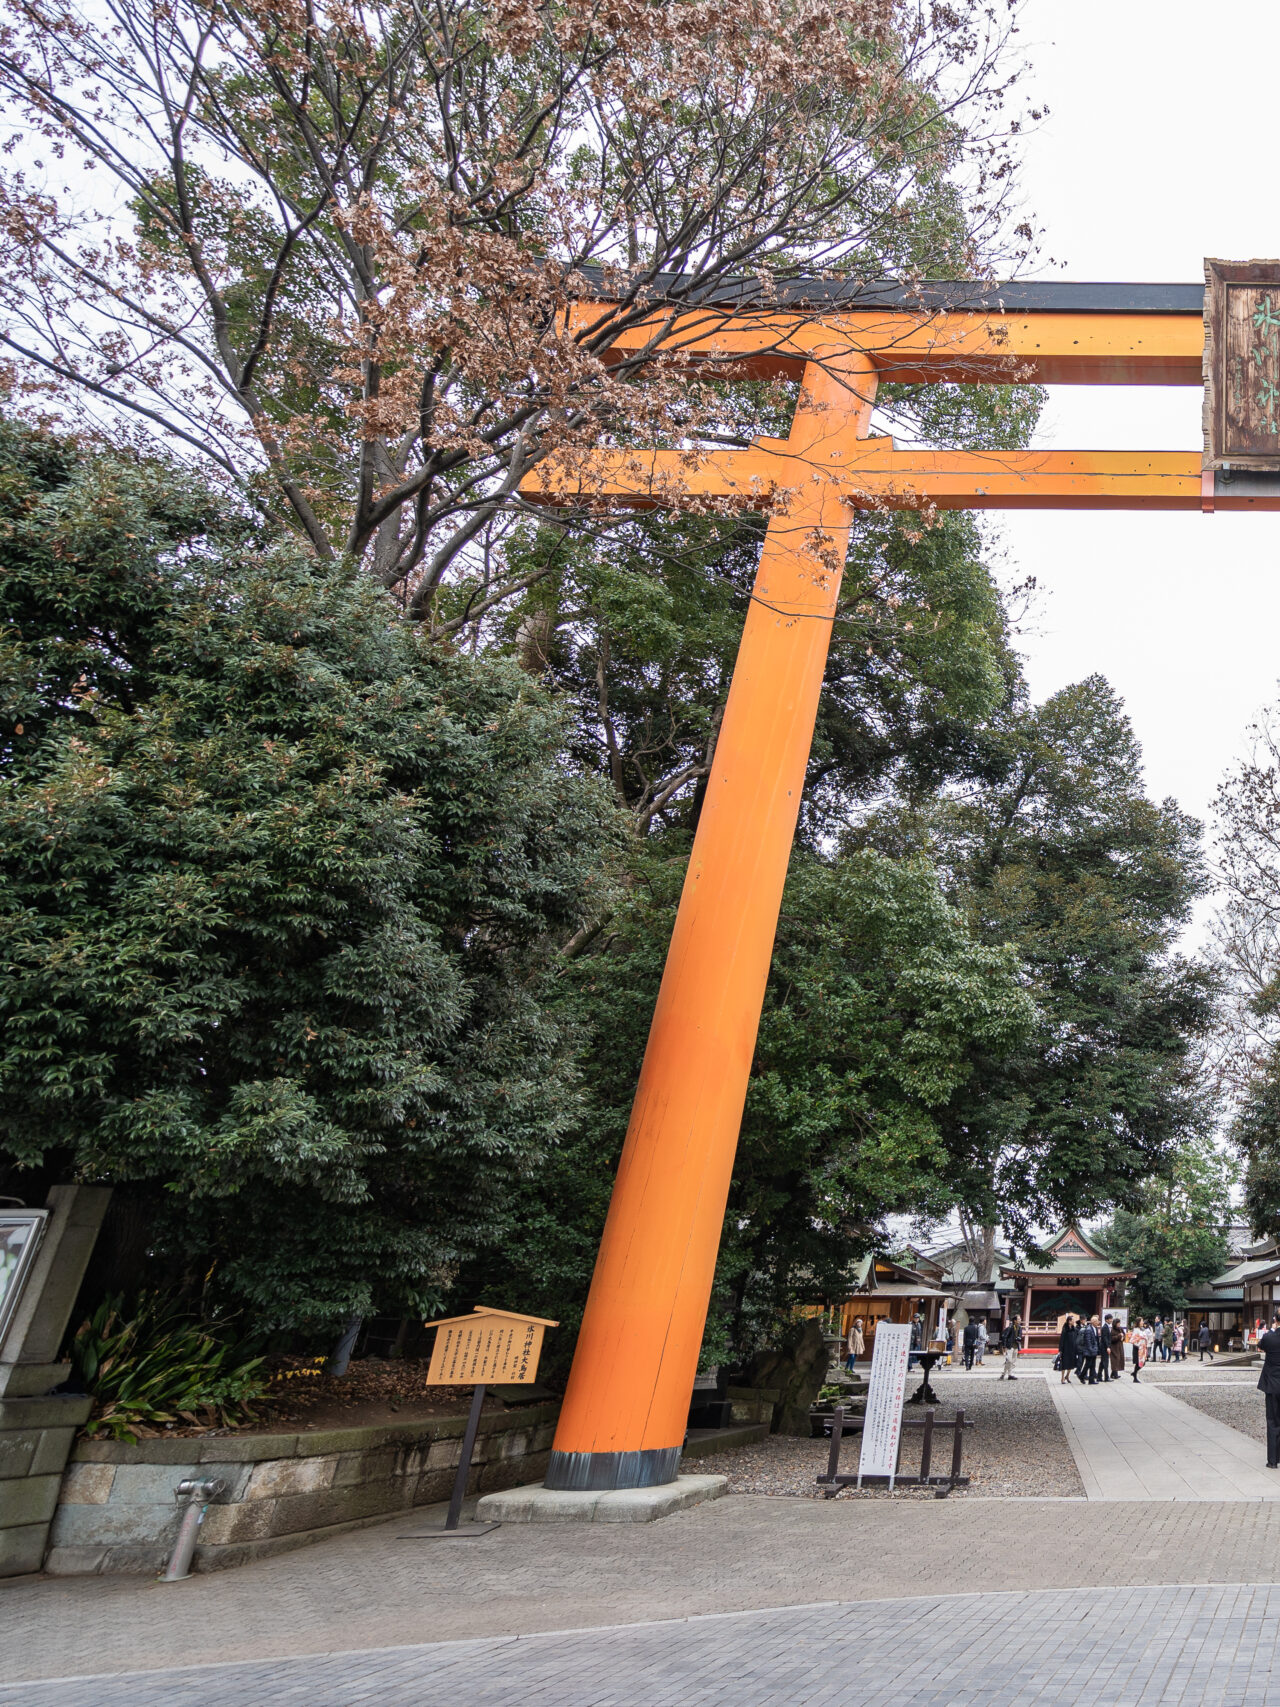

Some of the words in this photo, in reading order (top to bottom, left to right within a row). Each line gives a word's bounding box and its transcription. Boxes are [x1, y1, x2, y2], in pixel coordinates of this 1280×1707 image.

[517, 1324, 536, 1380] 氷川神社大鳥居
